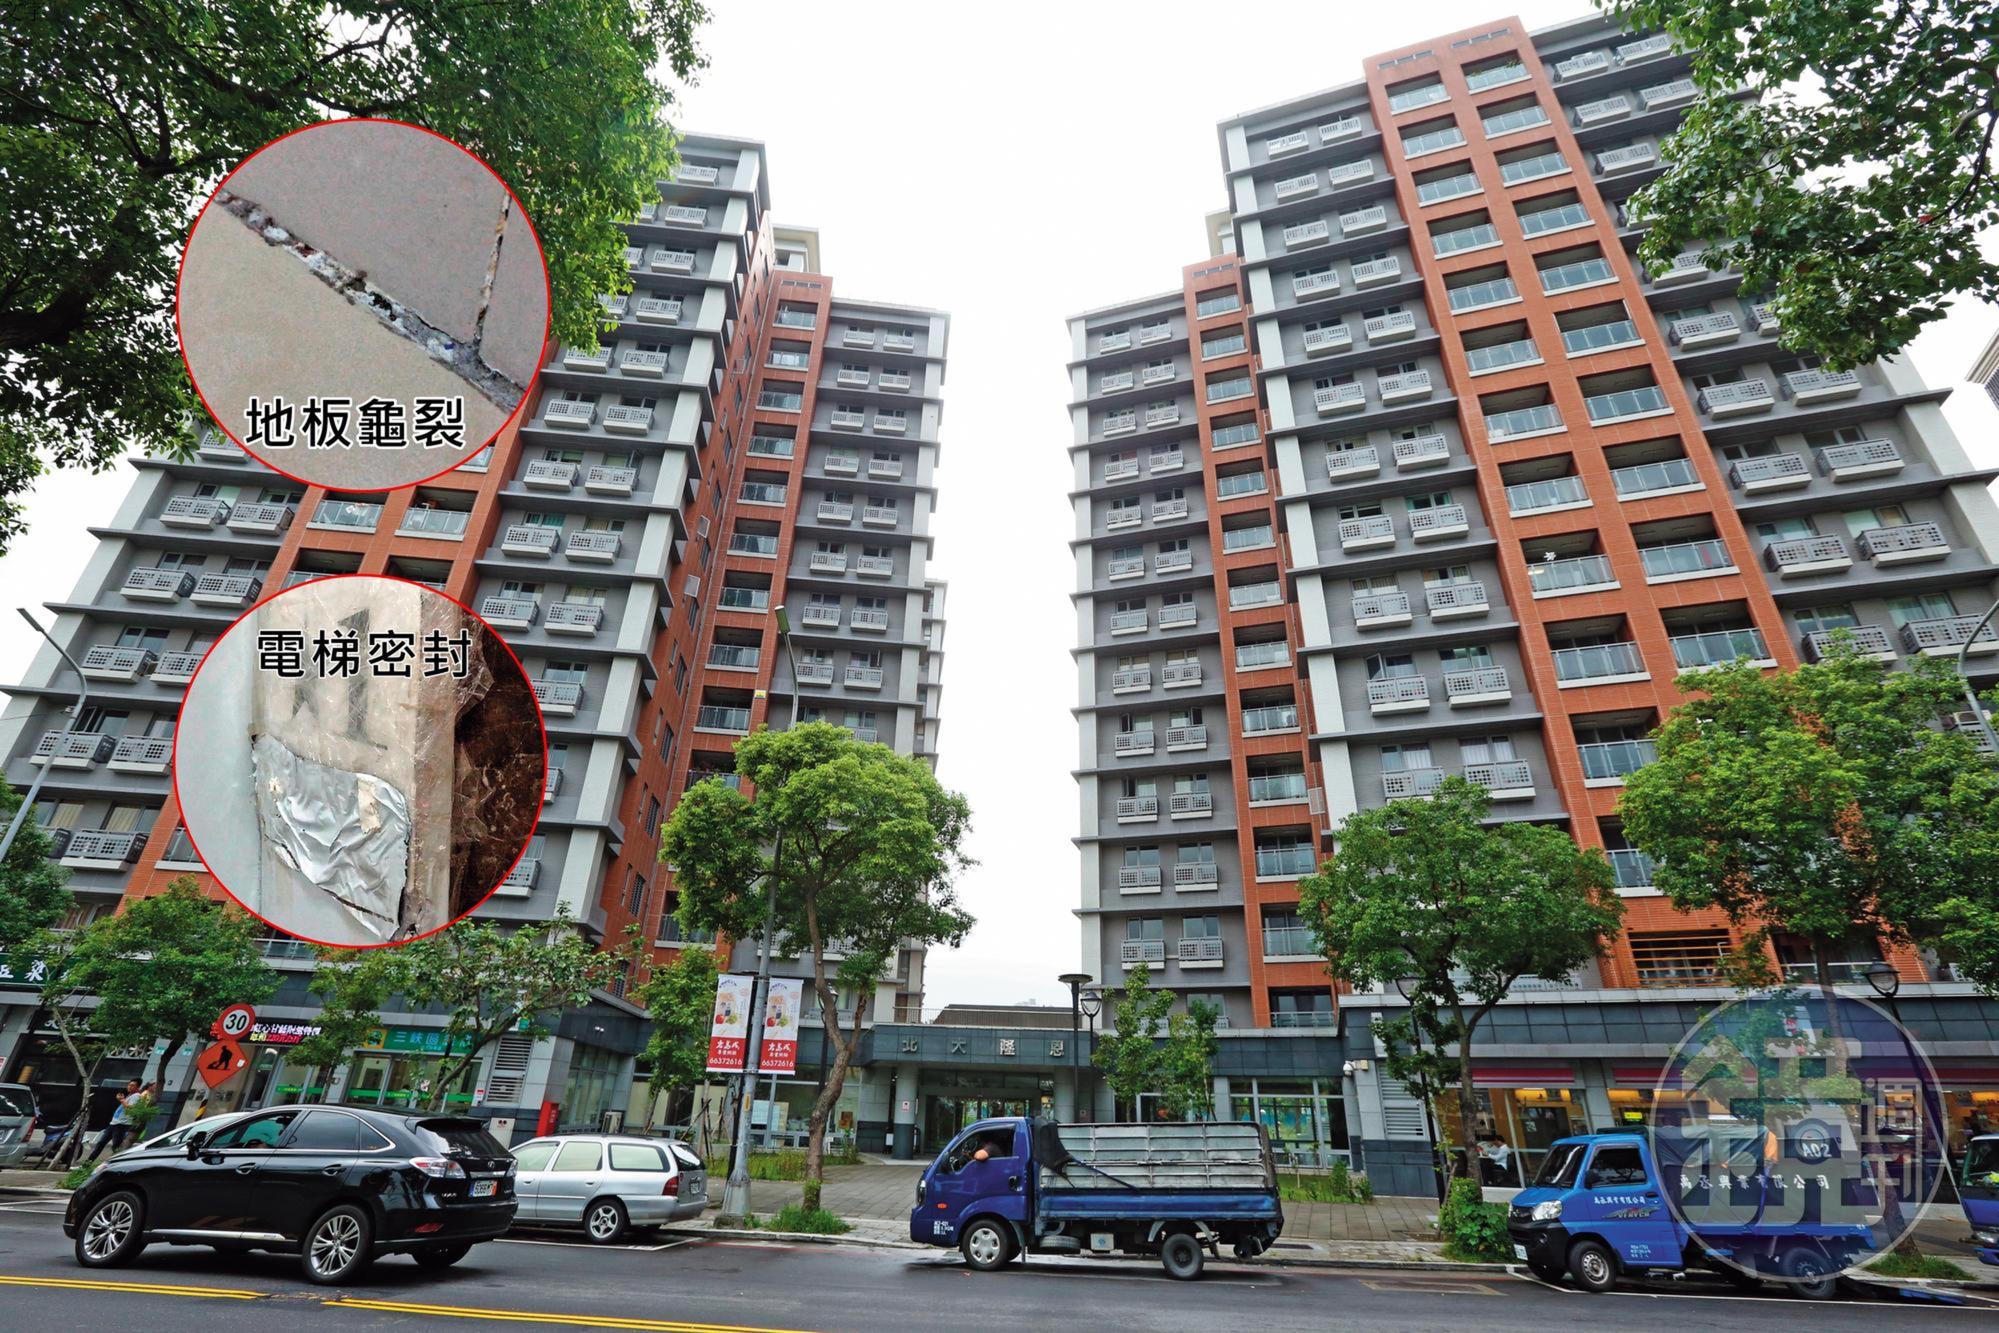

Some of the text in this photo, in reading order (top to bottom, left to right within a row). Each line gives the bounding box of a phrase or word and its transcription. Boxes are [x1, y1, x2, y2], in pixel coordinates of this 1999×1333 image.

[225, 1013, 248, 1030] 30
[902, 1038, 1065, 1057] 北大隆恩
[709, 1057, 743, 1065] 66372616
[761, 1059, 794, 1068] 66372616
[1802, 1143, 1832, 1158] A02
